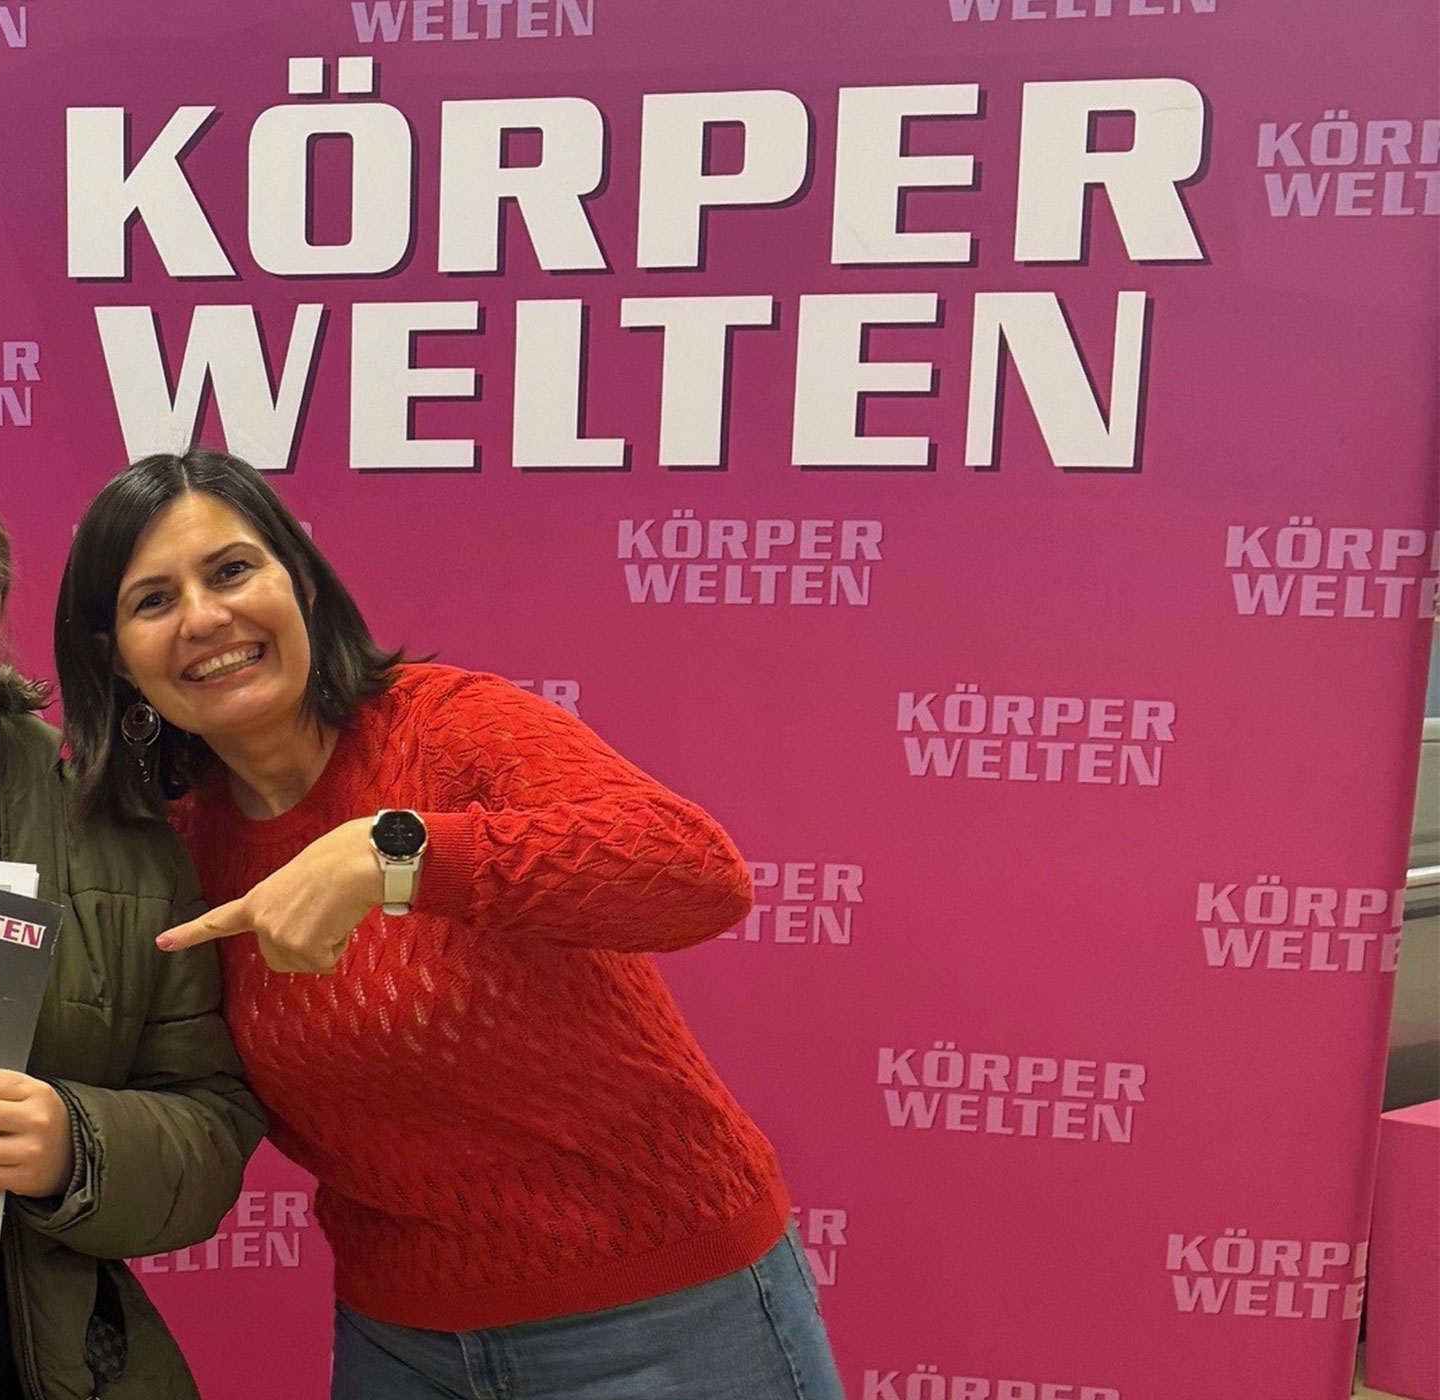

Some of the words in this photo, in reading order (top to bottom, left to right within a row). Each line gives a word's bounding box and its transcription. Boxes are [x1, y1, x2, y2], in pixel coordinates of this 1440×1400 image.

[351, 0, 595, 43] WELTEN
[66, 56, 1208, 280] KÖRPER
[93, 290, 1149, 471] WELTEN
[617, 509, 883, 561] KÖRPER
[1223, 516, 1440, 572] KÖRP
[623, 563, 871, 606] WELTEN
[896, 683, 1177, 743] KÖRPER
[902, 736, 1164, 787] WELTEN
[746, 861, 864, 903] PER
[717, 904, 853, 946] TEN
[876, 1041, 1148, 1102] KÖRPER
[882, 1089, 1135, 1144] WELTEN
